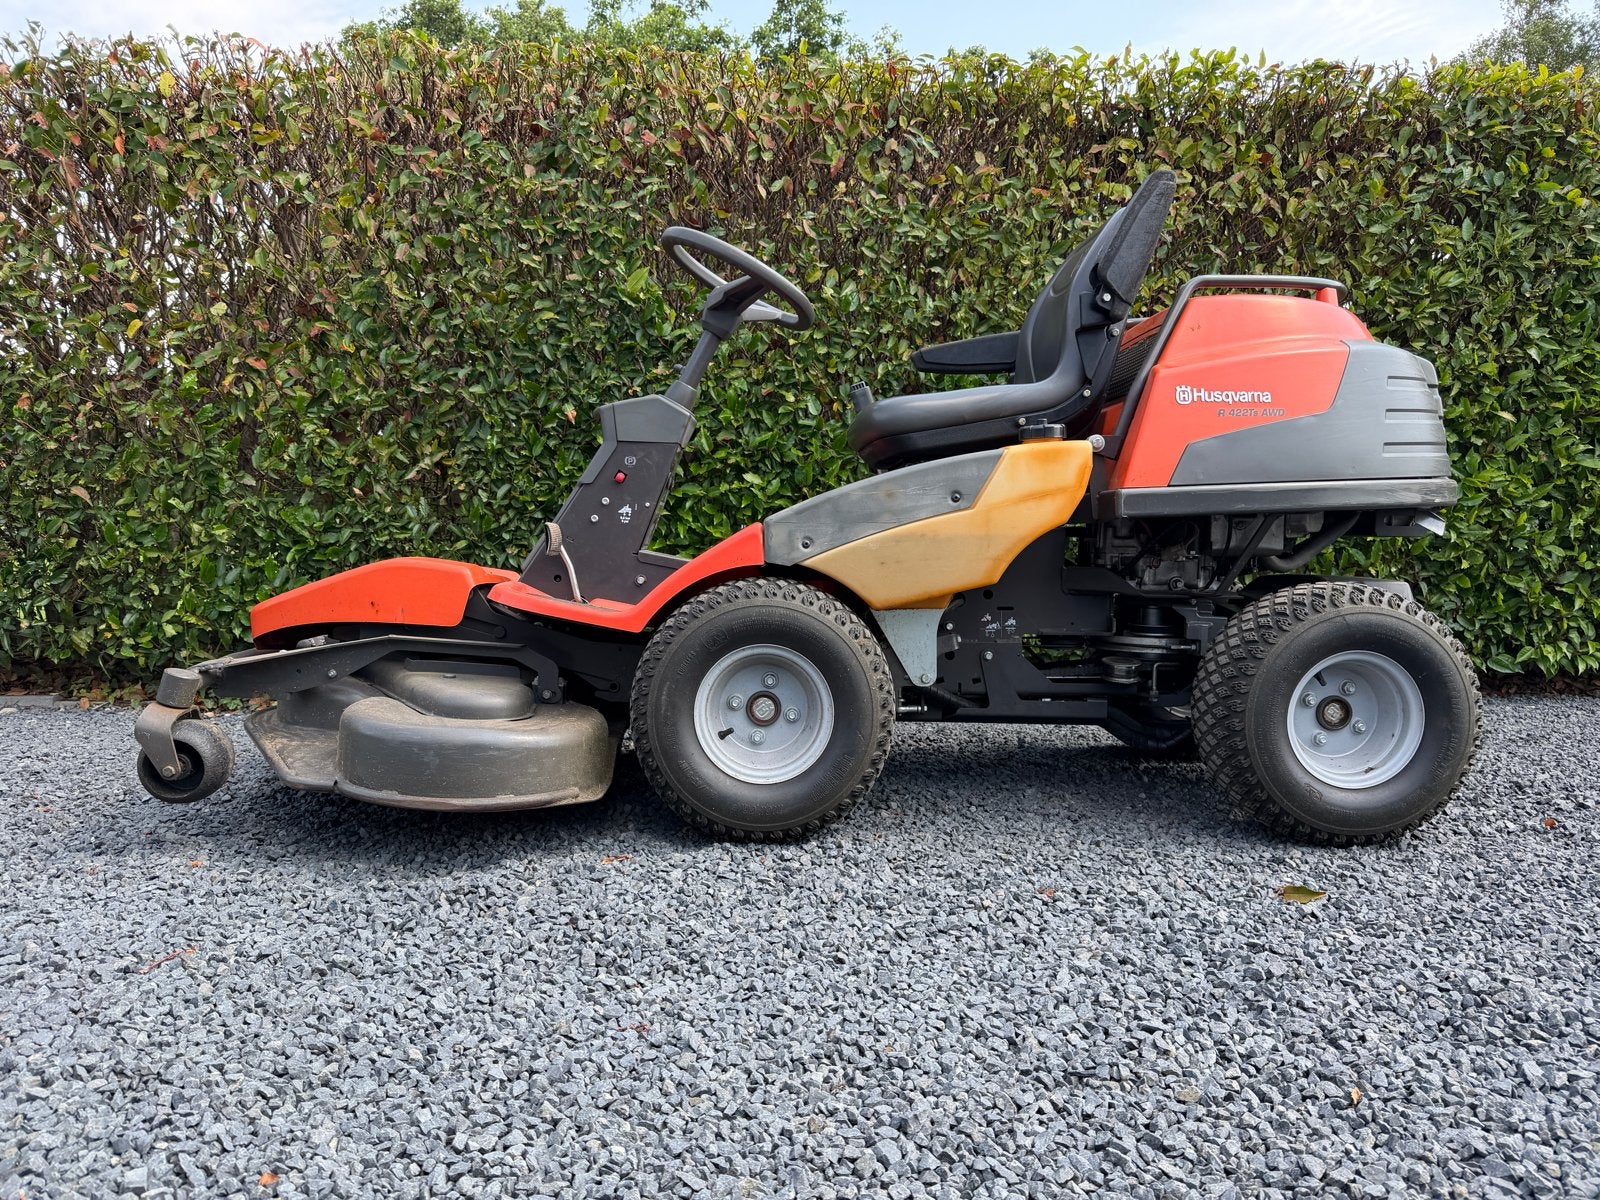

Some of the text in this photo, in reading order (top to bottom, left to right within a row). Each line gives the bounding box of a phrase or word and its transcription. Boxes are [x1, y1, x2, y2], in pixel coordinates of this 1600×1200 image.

[1193, 388, 1272, 404] Husqvarna
[1217, 408, 1285, 417] R 422Ts AWD
